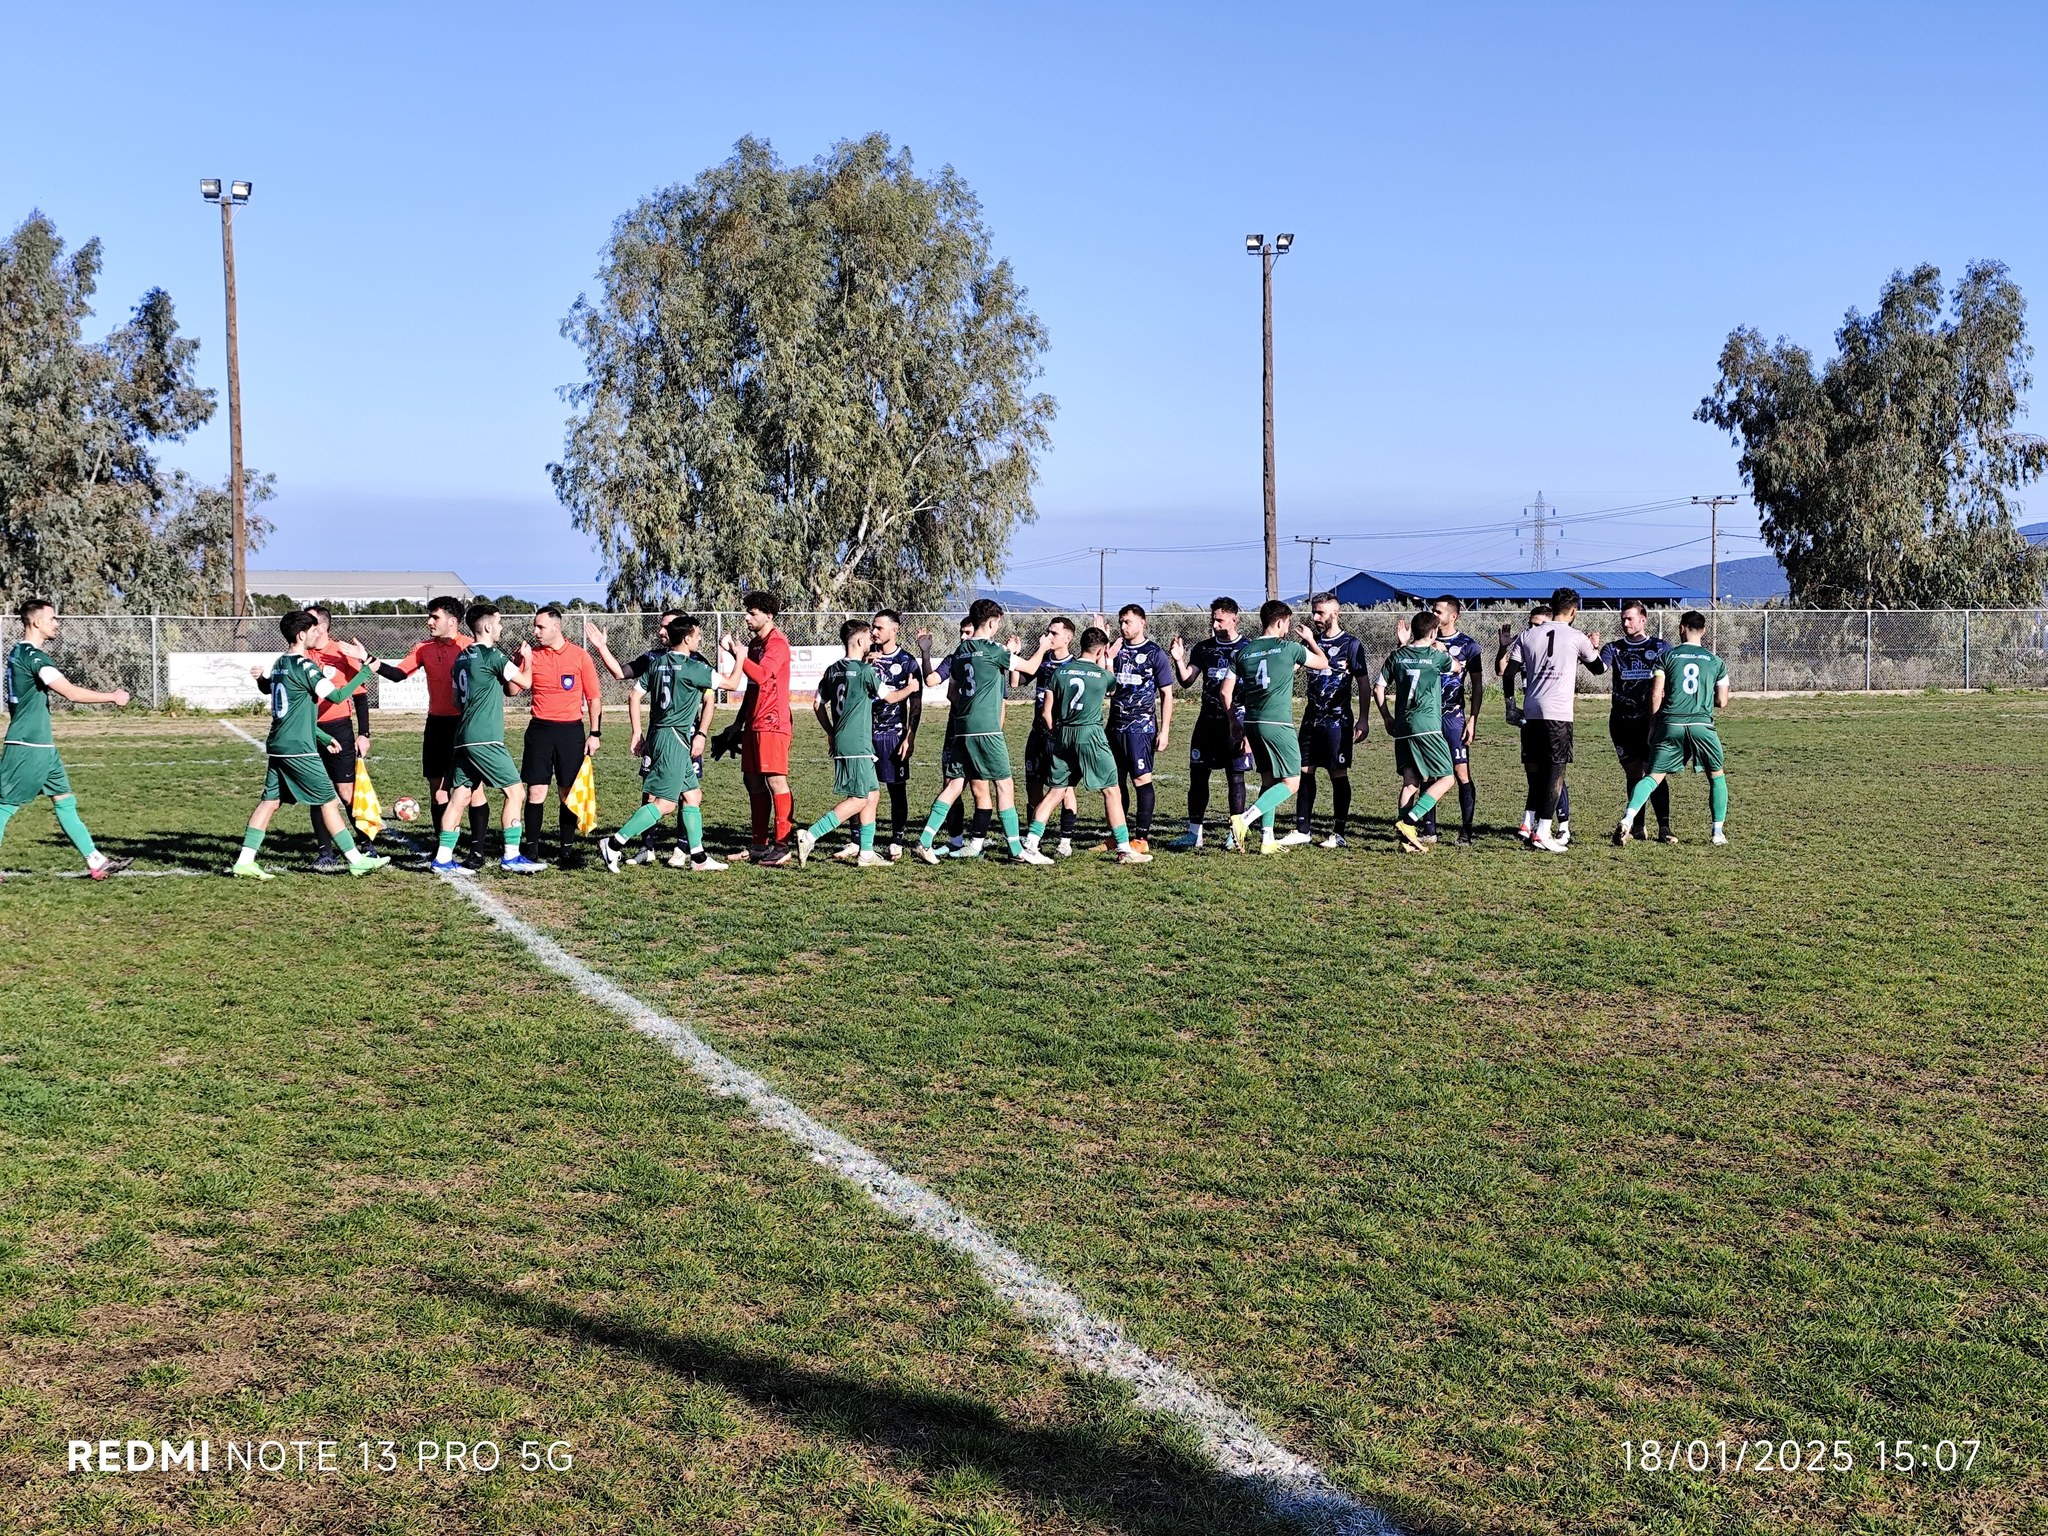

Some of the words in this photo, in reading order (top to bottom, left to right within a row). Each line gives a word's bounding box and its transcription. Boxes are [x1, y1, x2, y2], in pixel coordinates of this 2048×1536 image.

[1546, 629, 1555, 658] 1
[458, 668, 468, 704] 9
[963, 663, 976, 697] 3
[1255, 659, 1271, 690] 4
[1405, 668, 1421, 709] 7
[1682, 663, 1700, 695] 8
[660, 675, 671, 710] 5
[1069, 677, 1085, 711] 2
[1137, 758, 1145, 770] 5
[1338, 752, 1346, 764] 6
[1455, 748, 1467, 760] 10
[899, 766, 905, 777] 3
